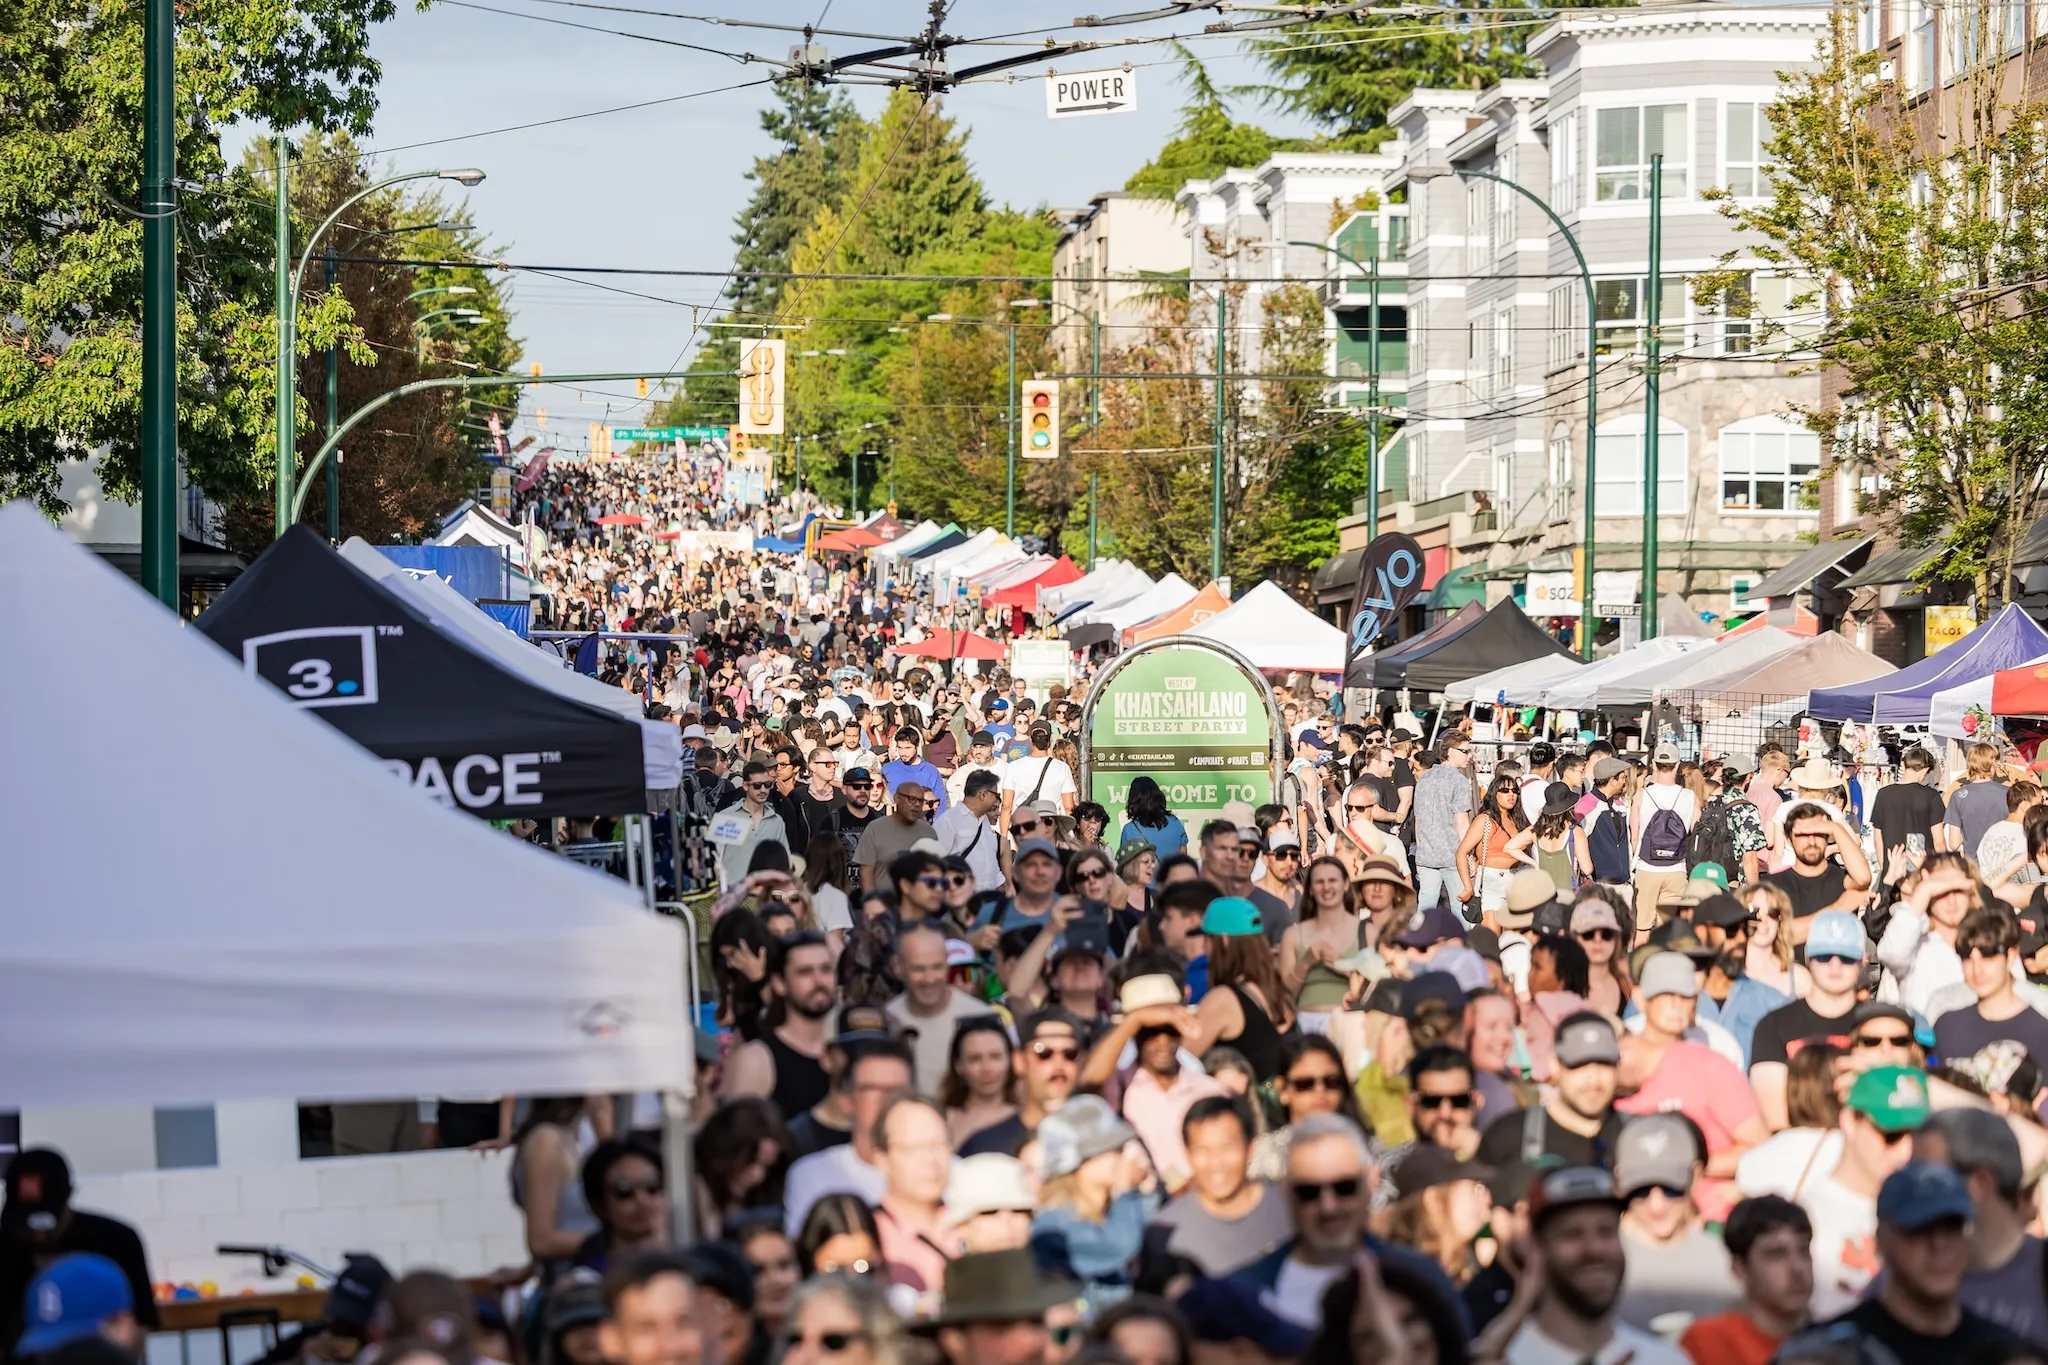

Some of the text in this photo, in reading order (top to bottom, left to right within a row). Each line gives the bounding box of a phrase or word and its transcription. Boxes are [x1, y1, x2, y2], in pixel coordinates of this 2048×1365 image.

[1058, 77, 1124, 103] POWER
[1351, 549, 1421, 654] evo
[1601, 605, 1635, 615] STEPHENS
[1928, 627, 1962, 636] TACOS
[1167, 679, 1183, 689] WEST
[1114, 691, 1247, 718] KHATSAHLANO
[1117, 721, 1244, 732] STREET PARTY
[1226, 784, 1256, 802] TO
